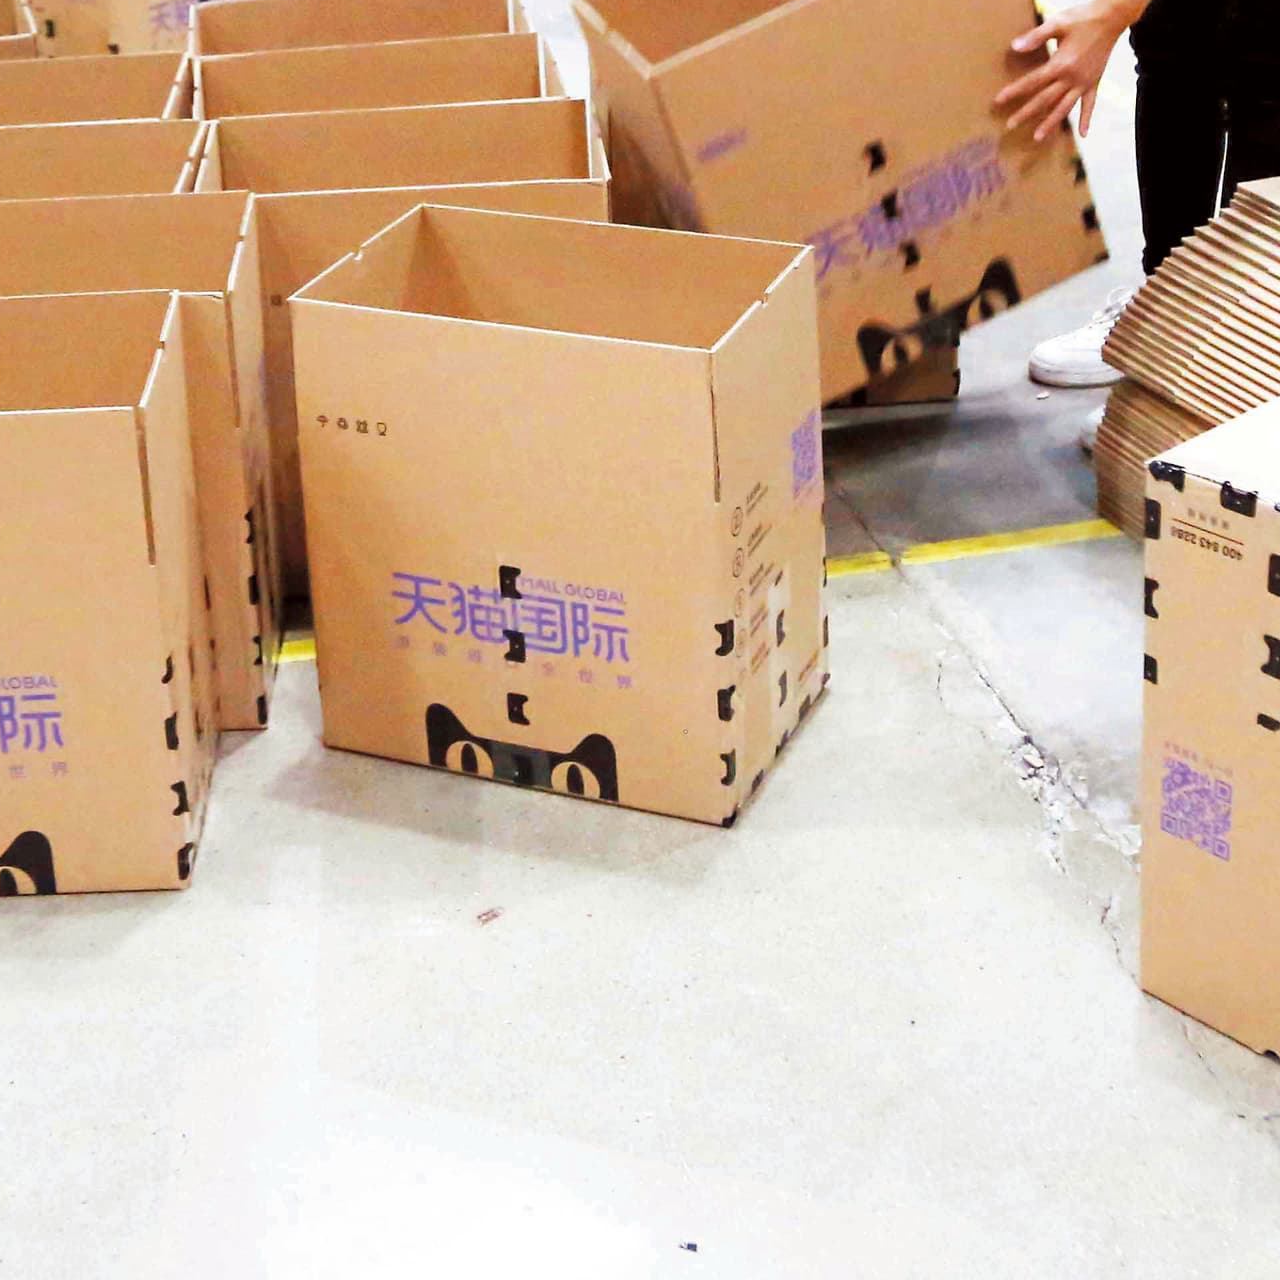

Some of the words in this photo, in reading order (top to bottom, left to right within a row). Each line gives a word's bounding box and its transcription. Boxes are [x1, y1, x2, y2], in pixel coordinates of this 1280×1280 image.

[391, 571, 630, 663] 天猫国际
[518, 575, 561, 596] MALL
[564, 582, 628, 605] GLOBAL
